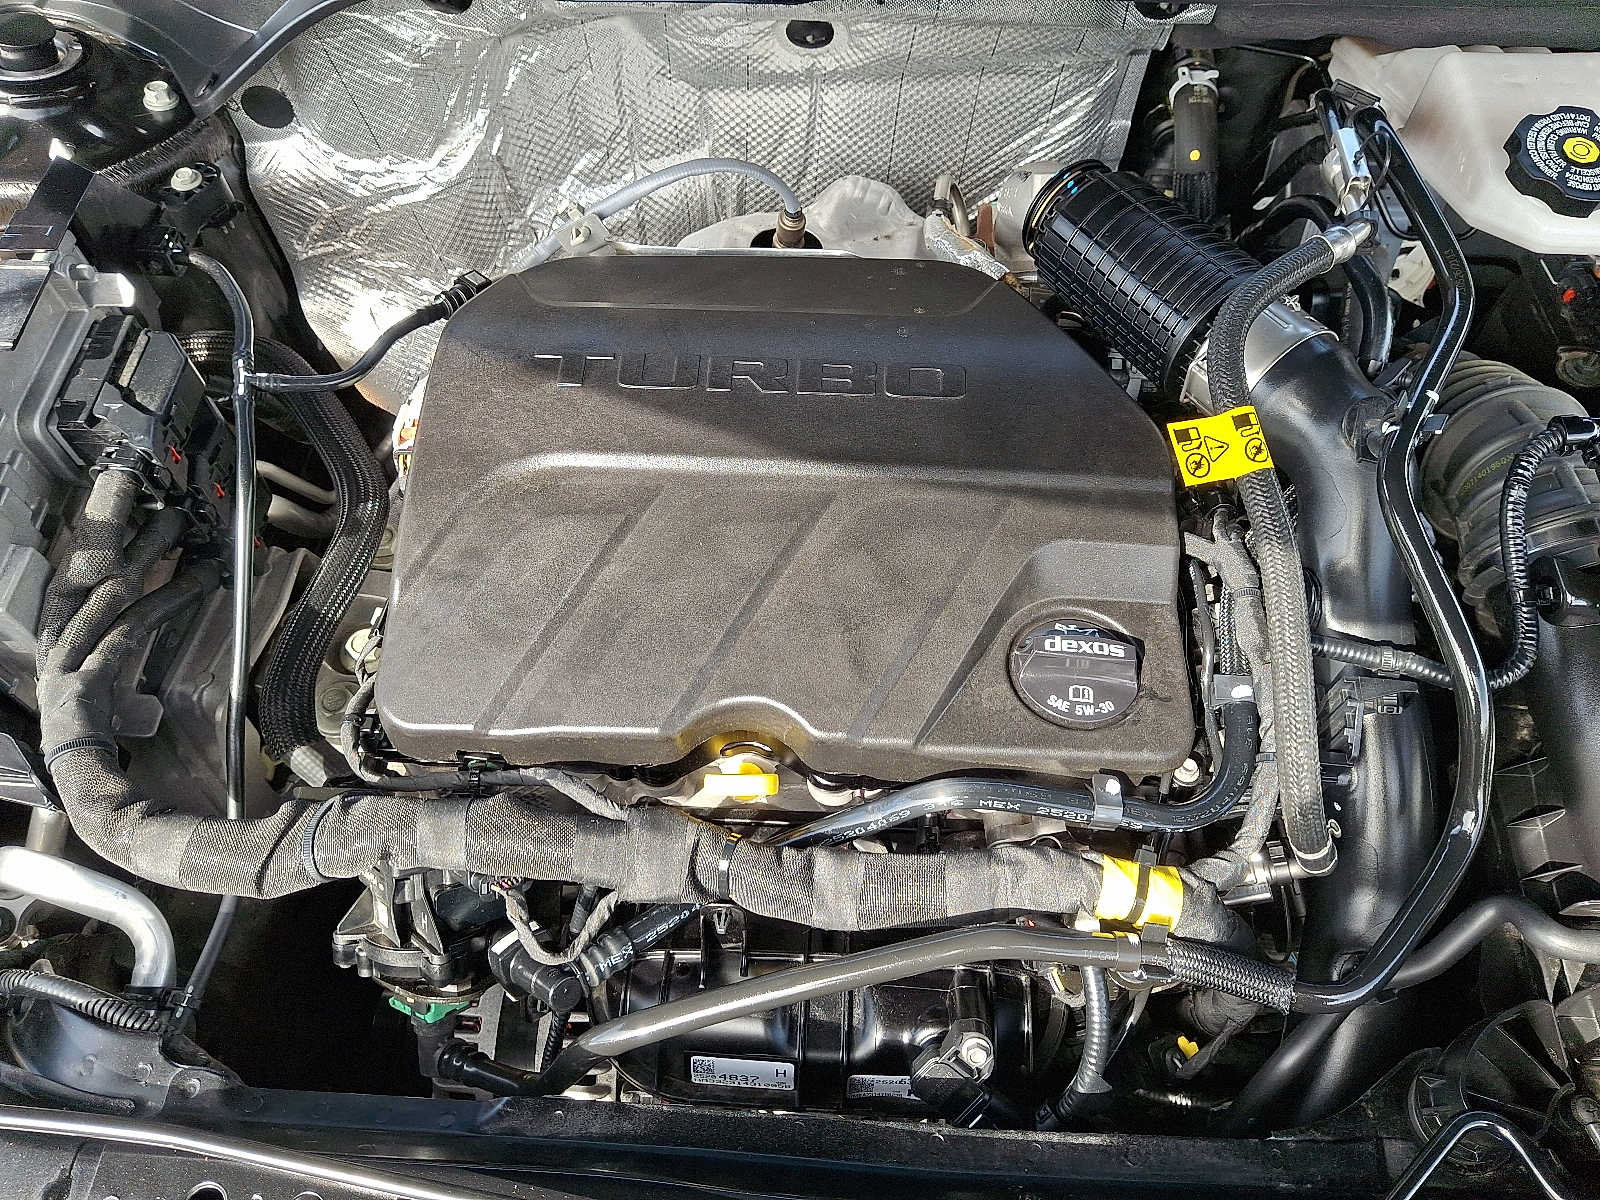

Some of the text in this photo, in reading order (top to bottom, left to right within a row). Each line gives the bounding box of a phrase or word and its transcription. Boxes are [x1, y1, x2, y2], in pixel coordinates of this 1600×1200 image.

[533, 354, 967, 399] TURBO
[1044, 636, 1126, 657] dexos
[1047, 694, 1115, 716] SAE 5W-30
[979, 799, 1021, 811] MEX
[599, 942, 634, 973] MEX
[775, 1068, 787, 1078] H
